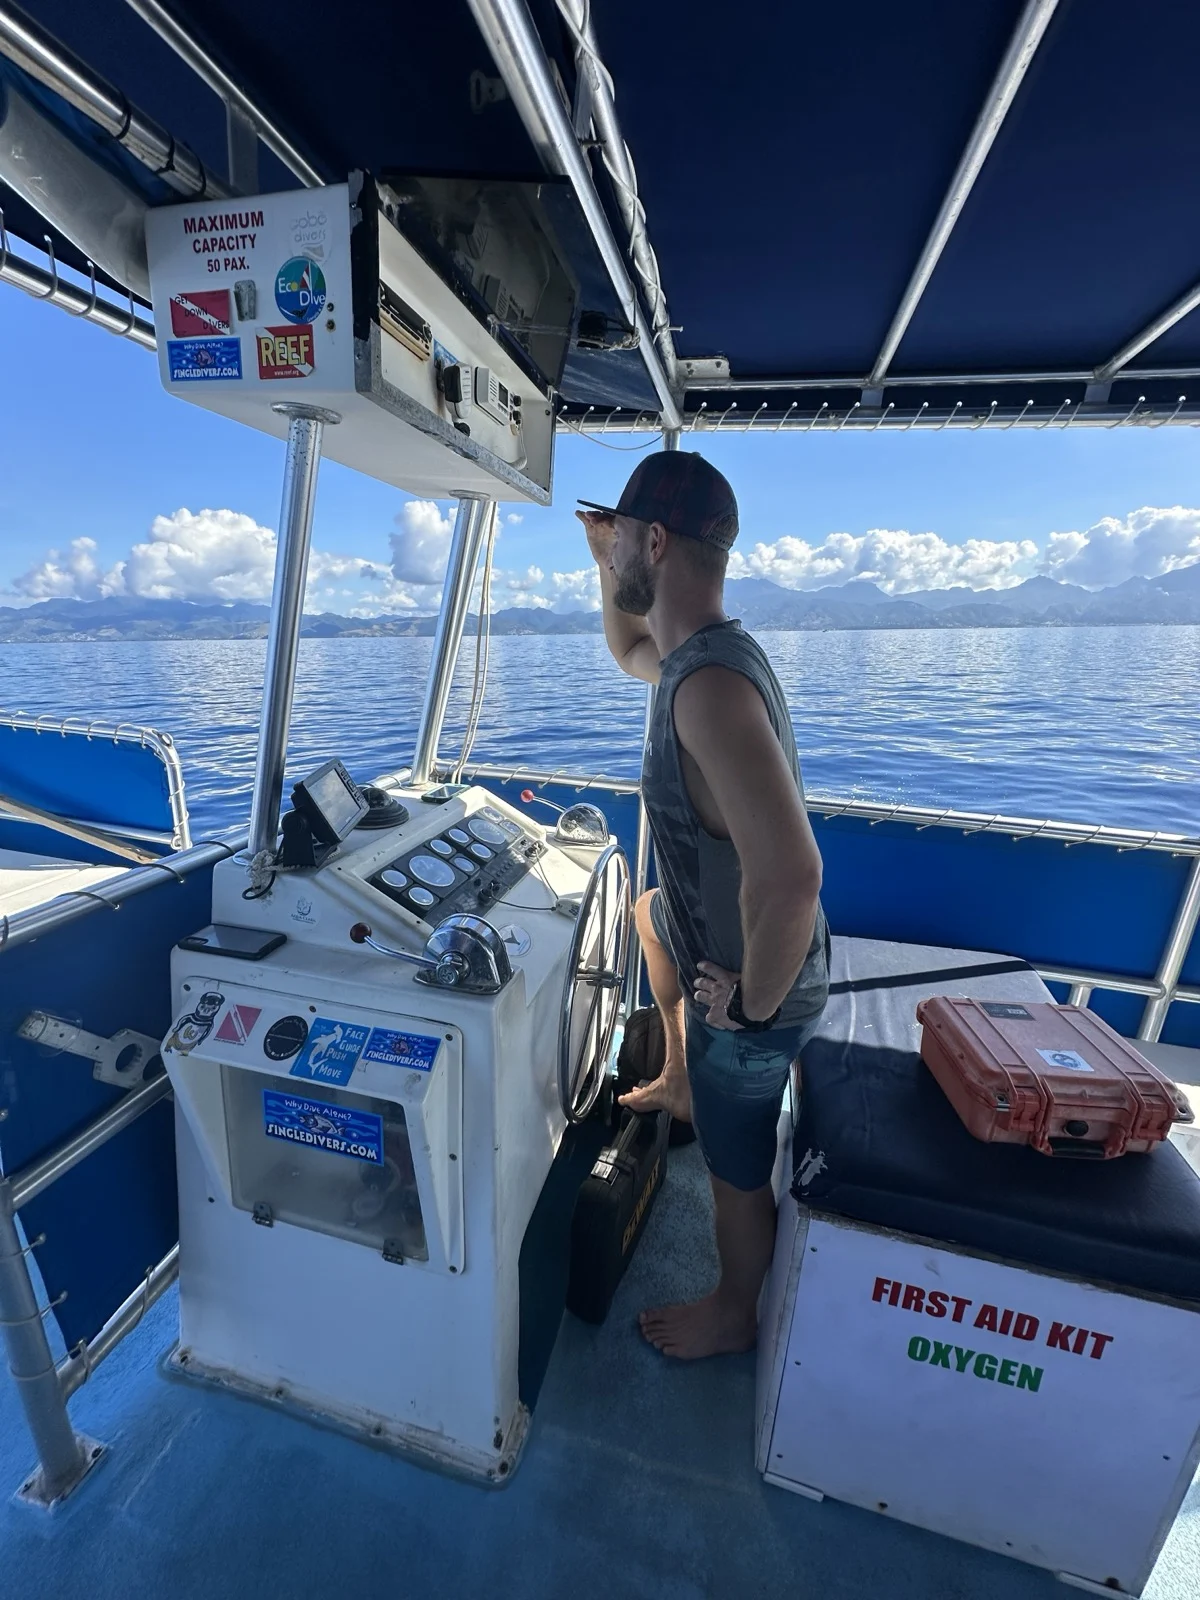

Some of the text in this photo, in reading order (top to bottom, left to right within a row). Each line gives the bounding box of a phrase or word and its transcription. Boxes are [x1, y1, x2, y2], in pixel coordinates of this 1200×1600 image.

[183, 210, 265, 234] MAXIMUM
[192, 233, 257, 254] CAPACITY
[207, 256, 250, 273] 50 PAX.
[174, 296, 188, 305] GET
[184, 306, 208, 317] DOWN
[203, 319, 230, 330] DIVERS
[260, 334, 310, 367] REEF
[173, 367, 239, 378] SINGLEDIVERS.COM
[339, 1040, 361, 1053] GUIDE
[366, 1050, 430, 1068] SINGLEDIVERS.COM
[318, 1064, 342, 1079] MOVE
[267, 1123, 378, 1160] SINGLEDIVERS.COM
[871, 1276, 1114, 1360] FIRST AID KIT
[907, 1335, 1044, 1393] OXYGEN
